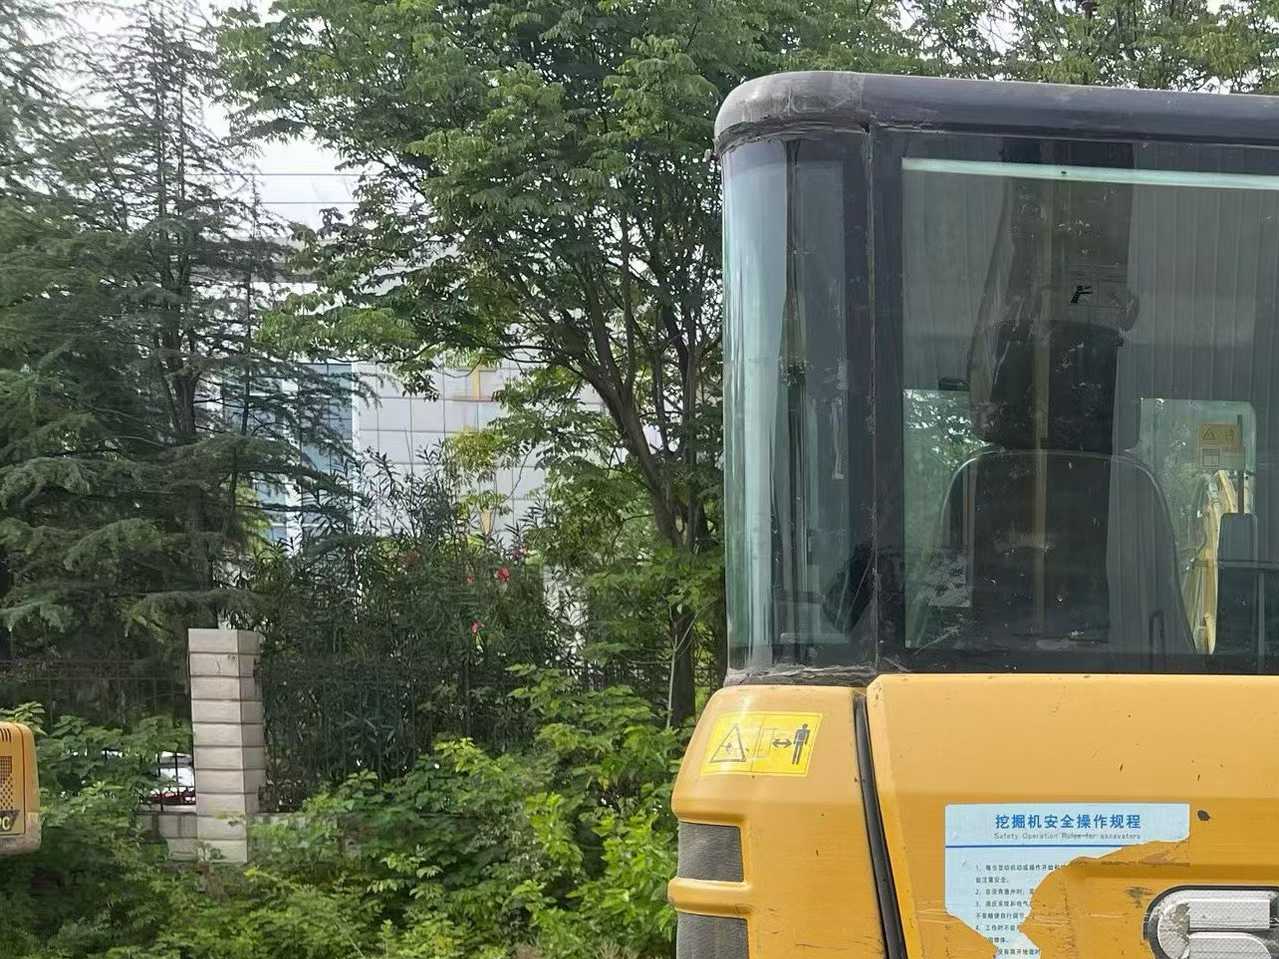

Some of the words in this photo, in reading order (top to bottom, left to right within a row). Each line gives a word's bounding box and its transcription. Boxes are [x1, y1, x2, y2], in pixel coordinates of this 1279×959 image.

[995, 814, 1142, 829] 挖掘机安全操作规程
[994, 832, 1019, 841] Safety
[1022, 832, 1060, 841] Operation
